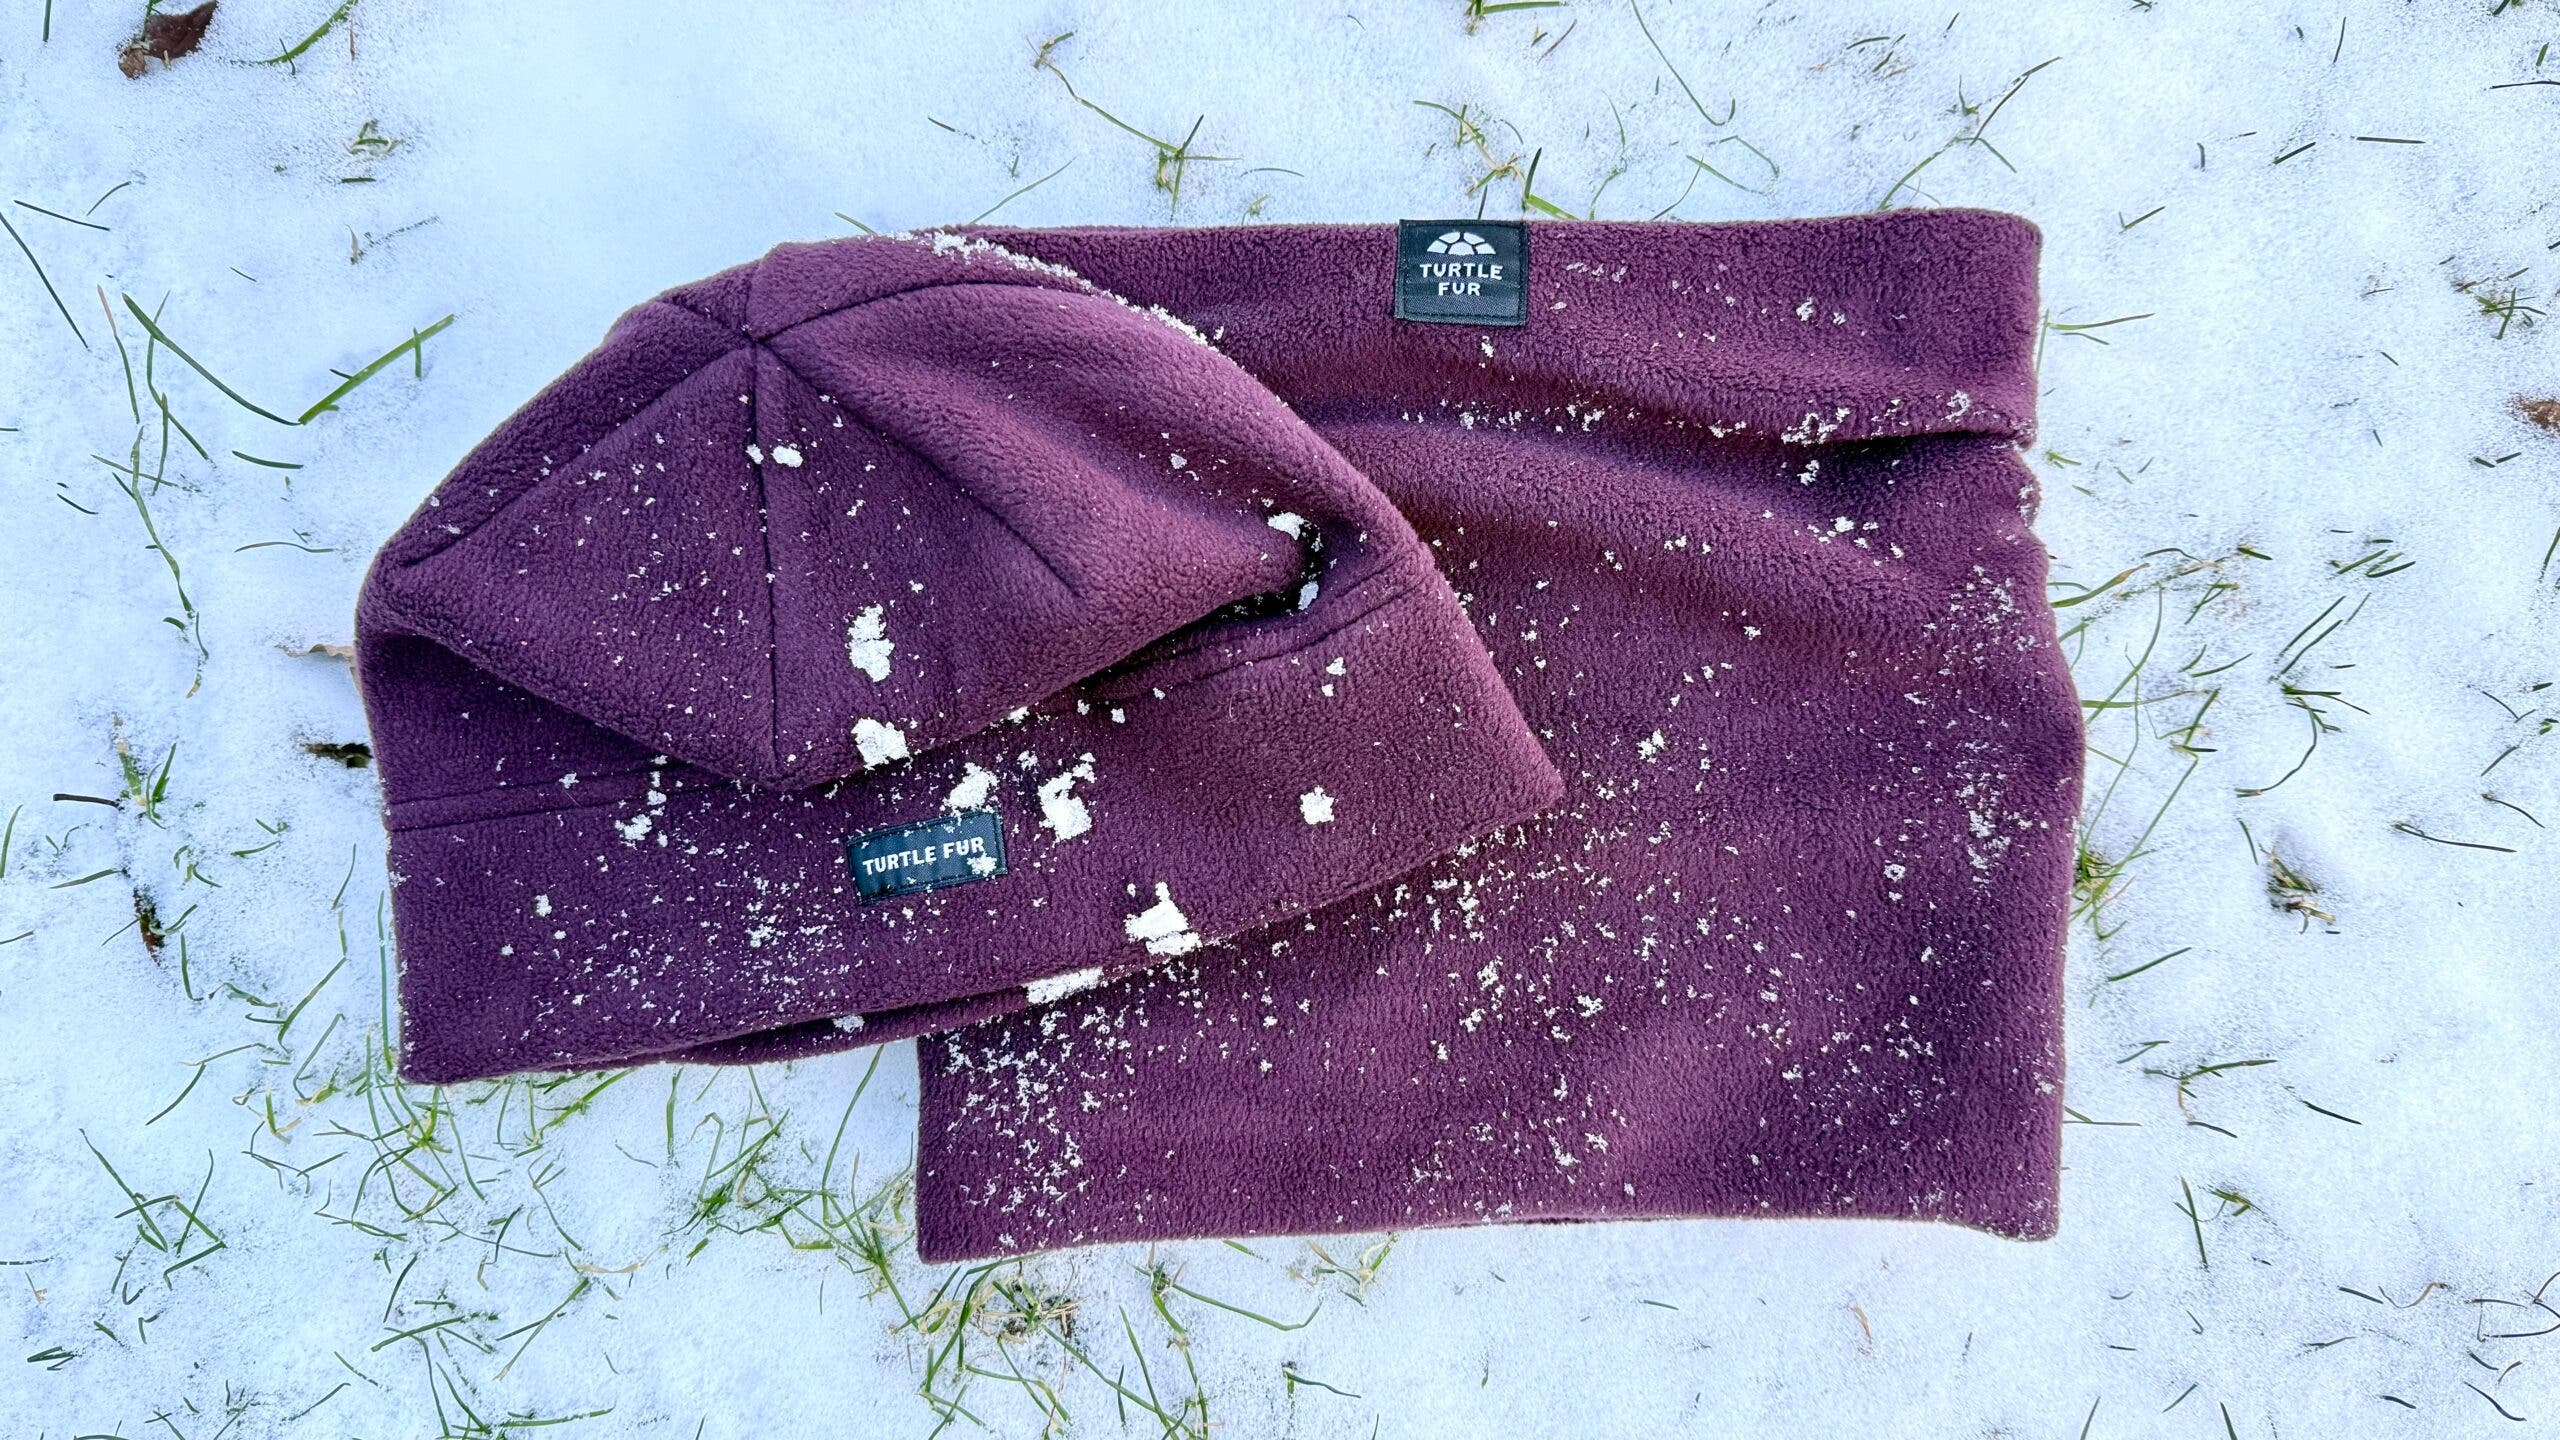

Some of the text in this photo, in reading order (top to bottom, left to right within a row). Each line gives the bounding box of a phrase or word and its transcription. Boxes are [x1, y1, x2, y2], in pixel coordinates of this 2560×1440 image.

[1420, 263, 1503, 280] TURTLE
[1438, 282, 1481, 296] FUR
[862, 837, 984, 875] TURTLE FUR
